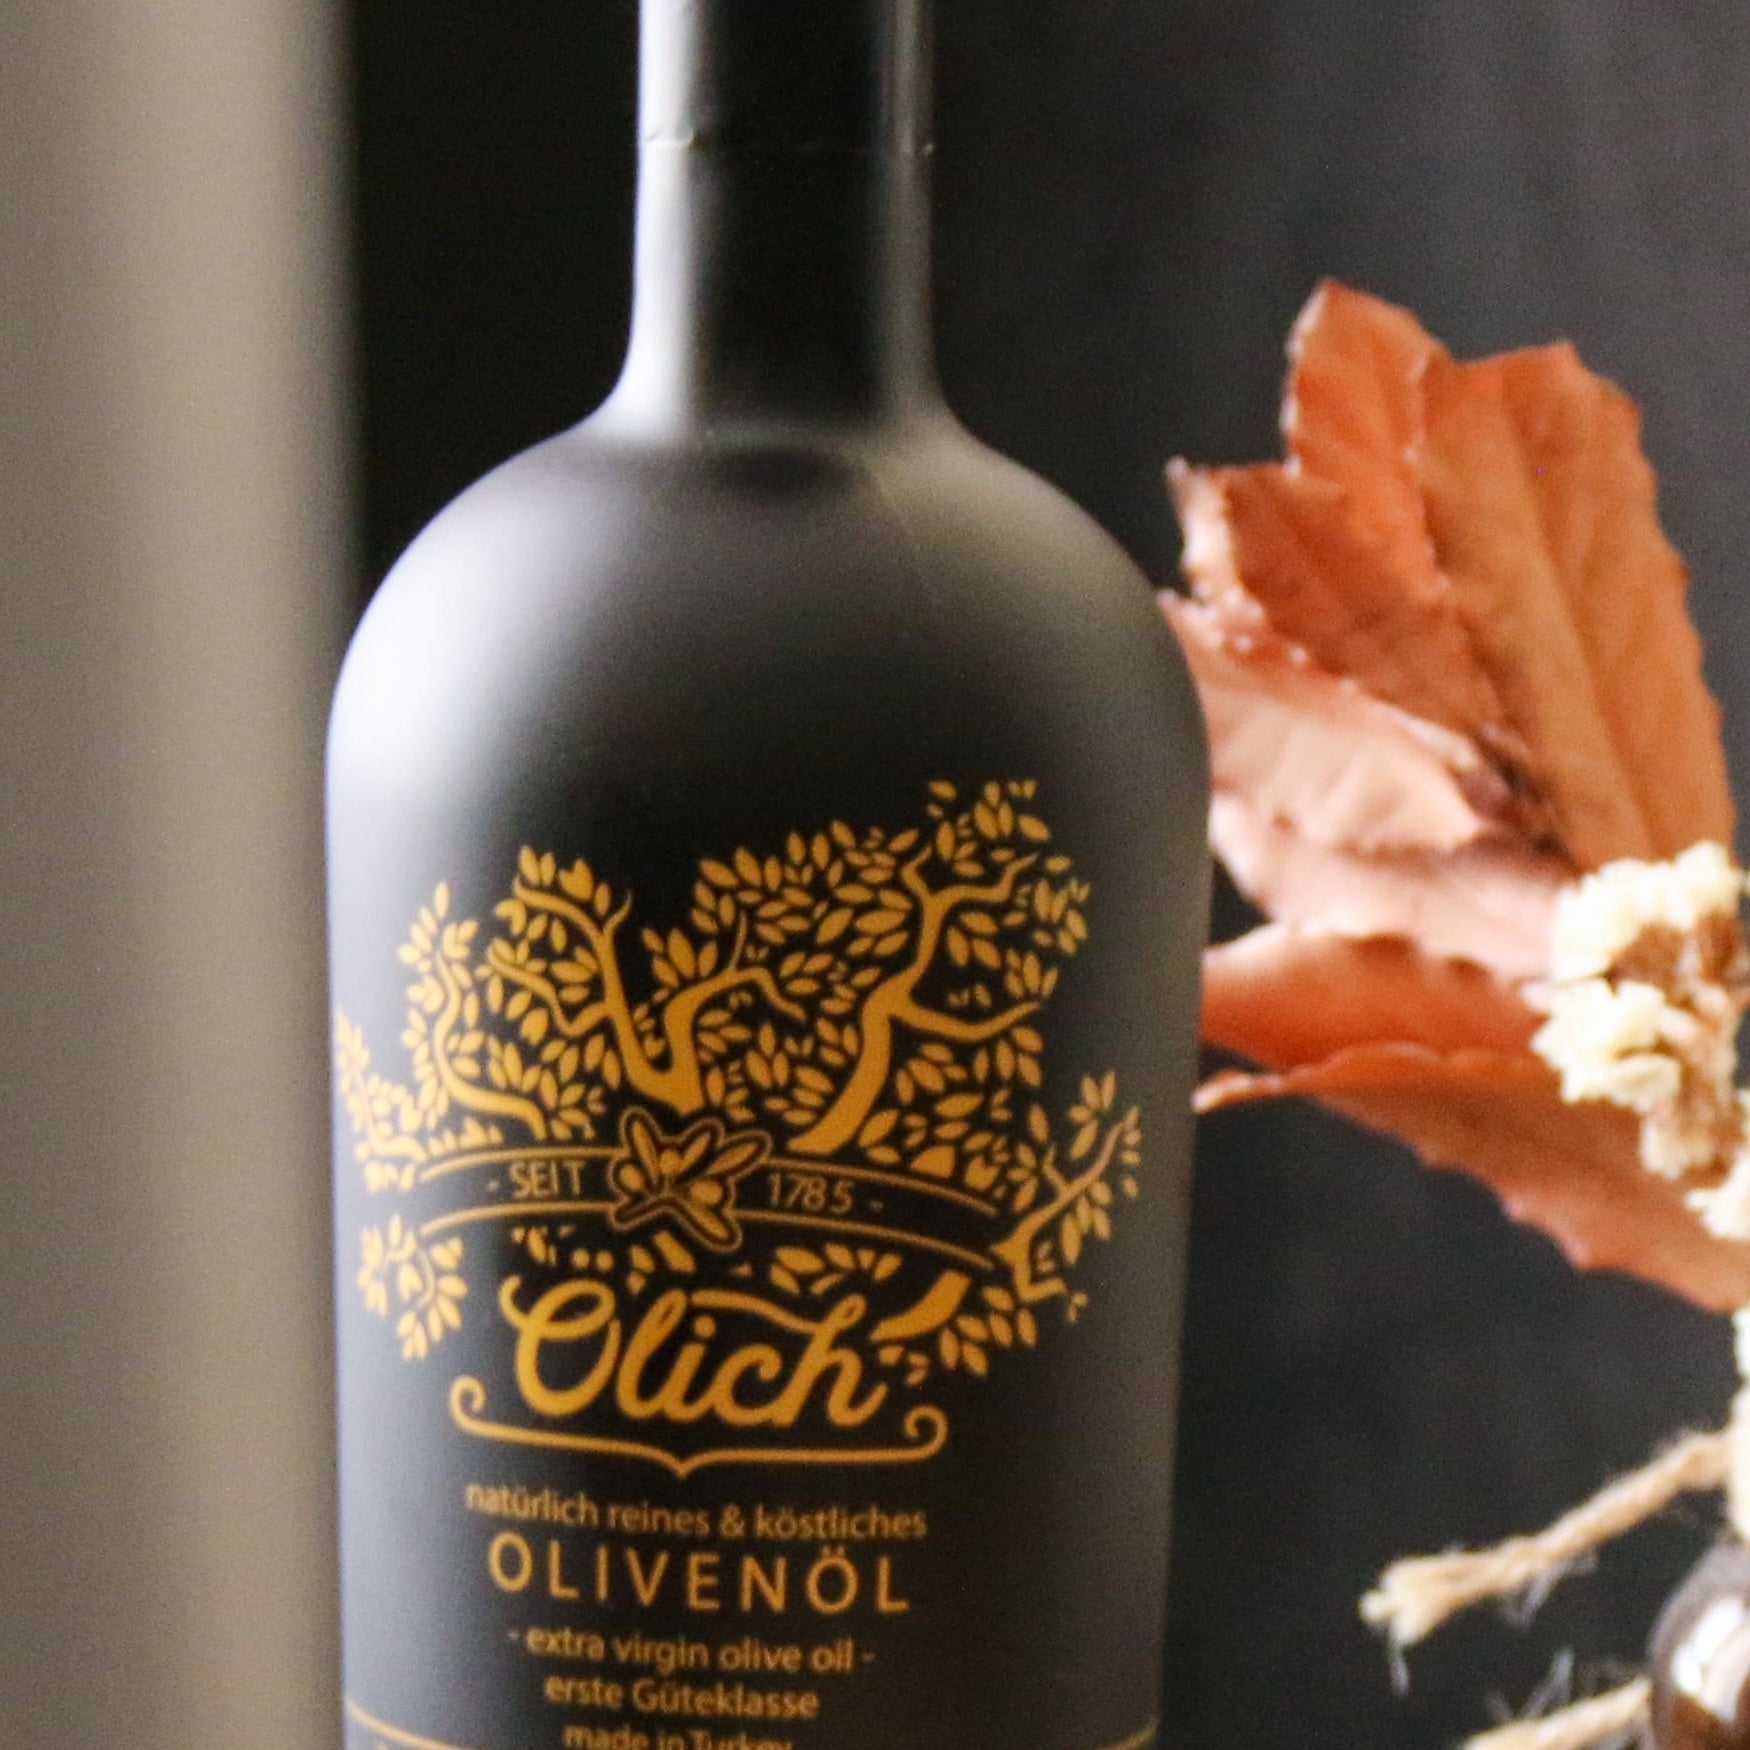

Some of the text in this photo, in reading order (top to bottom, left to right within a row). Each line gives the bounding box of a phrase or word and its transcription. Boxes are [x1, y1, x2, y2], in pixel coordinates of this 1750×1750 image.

[509, 1159, 855, 1214] SEIT 1785
[499, 1275, 888, 1426] Olich
[465, 1482, 928, 1539] natürlich reines & köstliches
[488, 1531, 909, 1614] OLIVENÖL
[525, 1626, 855, 1674] extra virgin olive oil
[543, 1674, 820, 1719] erste Güteklasse
